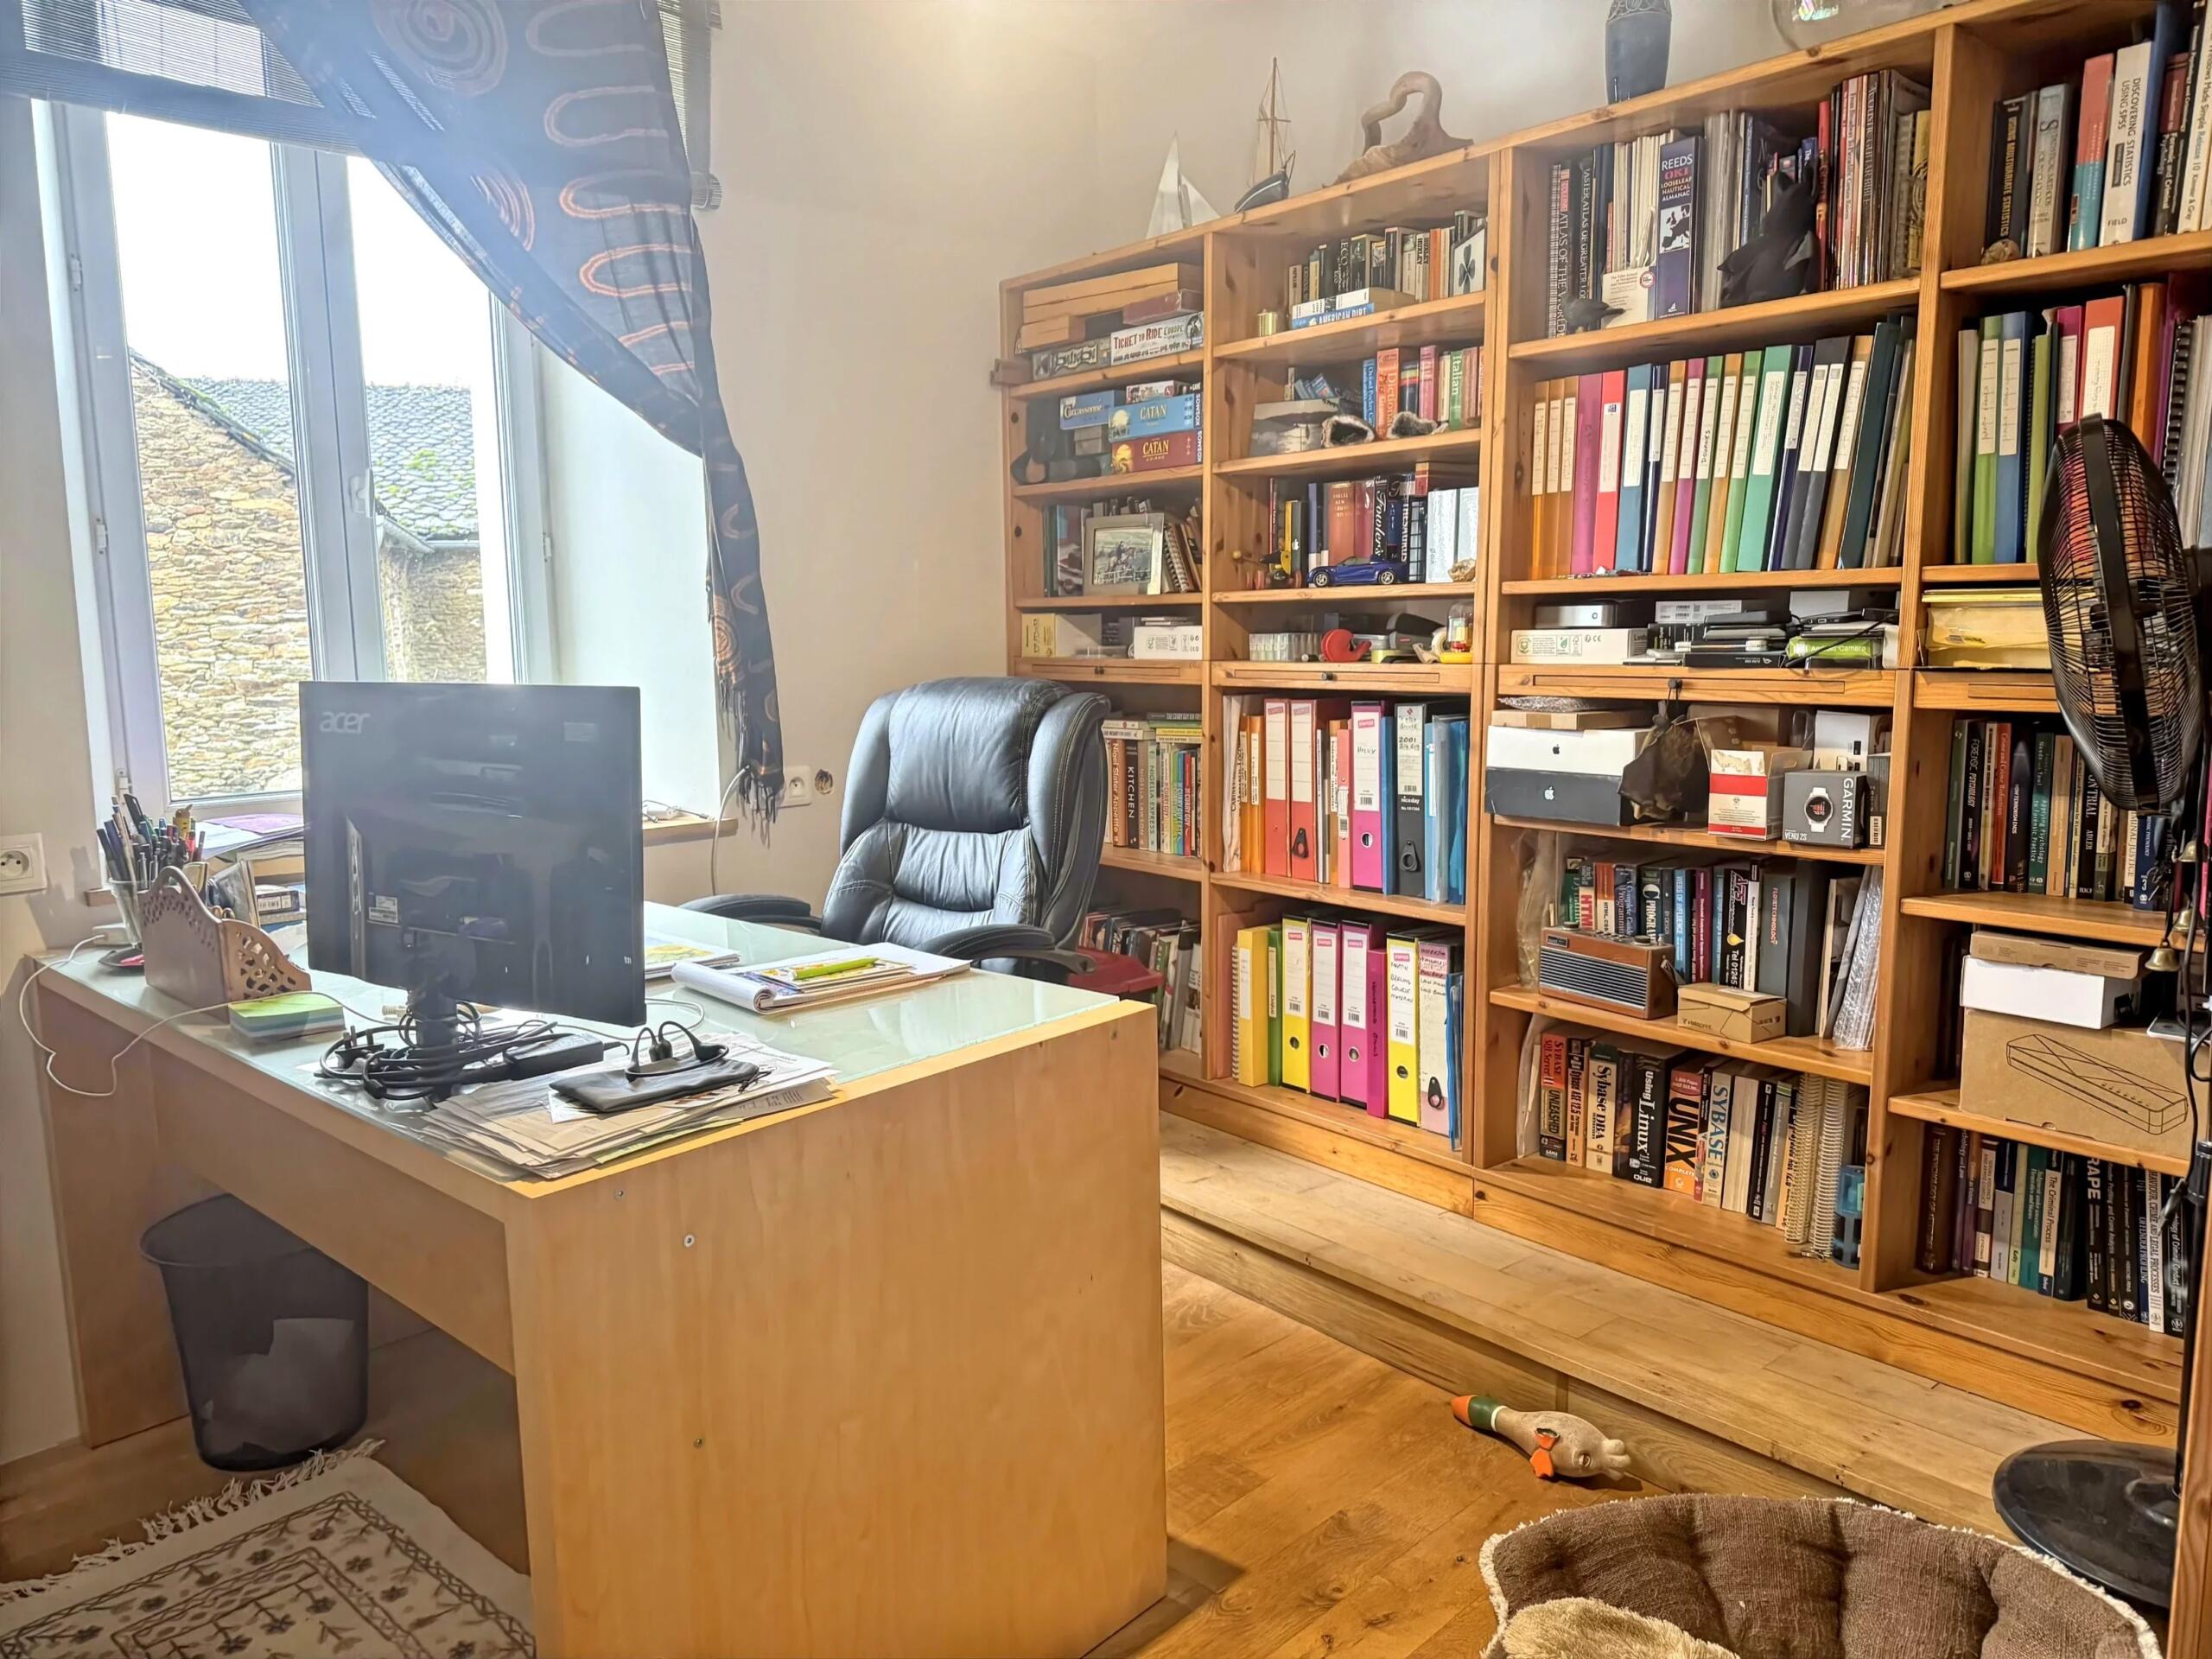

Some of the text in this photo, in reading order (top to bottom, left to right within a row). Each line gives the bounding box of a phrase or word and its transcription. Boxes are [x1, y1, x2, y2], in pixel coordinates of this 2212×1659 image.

[2117, 81, 2130, 130] USING SPSS
[2197, 104, 2208, 130] Simple
[2123, 78, 2141, 186] DISCOVERING STATISTICS
[2167, 133, 2177, 163] Forensic
[1662, 154, 1693, 171] REEDS
[1661, 177, 1692, 188] LOOSELEAF
[1662, 184, 1690, 195] NAUTICAL
[2000, 117, 2018, 237] USING MULTIVARIATE STATISTICS
[1662, 191, 1690, 202] ALMANAC
[2107, 217, 2127, 226] FIELD
[1581, 230, 1589, 243] OF
[1558, 213, 1568, 289] ATLAS OF THE
[1580, 243, 1588, 283] GREATER
[1318, 311, 1351, 325] AMERICAN
[1114, 334, 1138, 349] TICKET
[1146, 327, 1163, 340] RIDE
[1452, 354, 1462, 396] Italian
[1064, 404, 1103, 418] Carcassonne
[1140, 404, 1166, 419] CATAN
[1142, 439, 1169, 454] CATAN
[1374, 490, 1387, 556] Fowler's
[319, 710, 370, 734] acer
[1969, 739, 1980, 770] FORENSIC
[1401, 796, 1420, 804] niceday
[1967, 772, 1978, 807] PSYCHOLOGY
[1840, 778, 1854, 842] GARMIN
[2085, 788, 2098, 818] TRIAL
[1785, 832, 1799, 841] VENU
[2037, 799, 2048, 864] Applying Psychology
[2085, 830, 2094, 850] ADLER
[2030, 836, 2038, 862] Practice
[2127, 843, 2136, 877] JUSTICE
[1643, 884, 1660, 899] C
[1616, 888, 1626, 935] Programmin
[1731, 961, 1739, 984] 01245
[1543, 1053, 1553, 1076] Server
[1554, 1041, 1564, 1076] SYBASE
[1569, 1070, 1582, 1115] Sybase ASE 12.5
[1592, 1065, 1612, 1140] Sybase DBA
[1548, 1090, 1560, 1135] UNLEASHED
[1637, 1071, 1656, 1153] Using Linux
[1707, 1085, 1728, 1161] SYBASE
[1666, 1096, 1700, 1169] UNIX
[1545, 1148, 1558, 1157] SAMS
[1633, 1174, 1652, 1184] QUE
[2087, 1158, 2101, 1199] RAPE
[2047, 1189, 2056, 1217] Criminal
[2149, 1202, 2158, 1223] CRIME
[2045, 1218, 2055, 1243] Process
[2139, 1217, 2147, 1249] OFFENDER
[2150, 1236, 2158, 1256] LEGAL
[2171, 1241, 2181, 1262] Criminal
[2151, 1257, 2160, 1294] PROCESSES
[2171, 1263, 2181, 1286] Conduct
